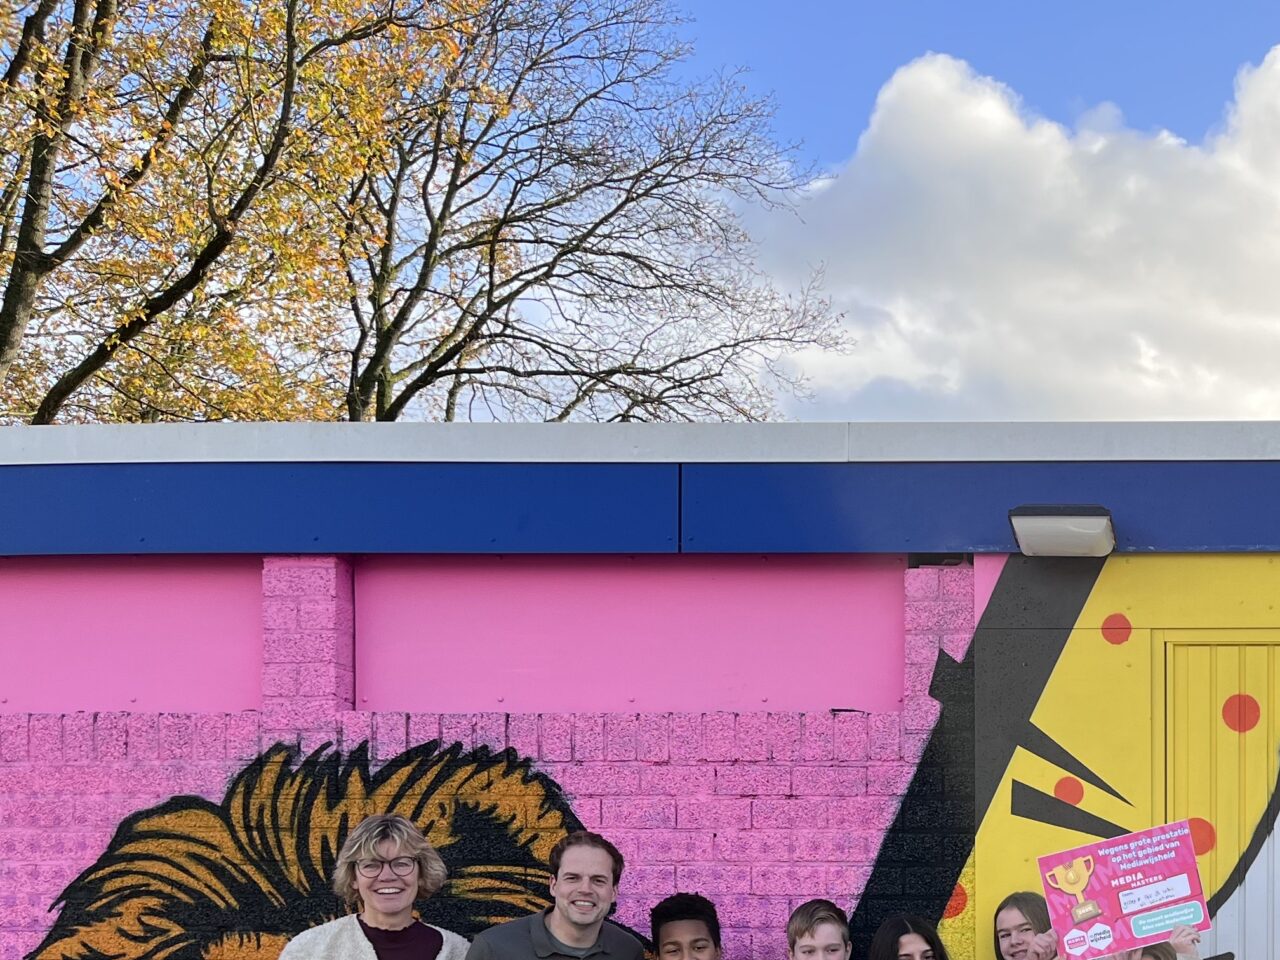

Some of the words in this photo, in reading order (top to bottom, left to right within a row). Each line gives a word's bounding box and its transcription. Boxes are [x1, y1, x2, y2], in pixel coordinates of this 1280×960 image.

[1098, 843, 1129, 856] Wegens
[1129, 837, 1151, 850] grote
[1152, 827, 1190, 844] prestatie
[1111, 856, 1122, 864] op
[1122, 850, 1137, 860] het
[1137, 843, 1165, 858] gebied
[1164, 840, 1180, 849] van
[1119, 850, 1176, 870] Mediawijsheid
[1110, 871, 1144, 887] MEDIA
[1130, 874, 1163, 888] MASTERS
